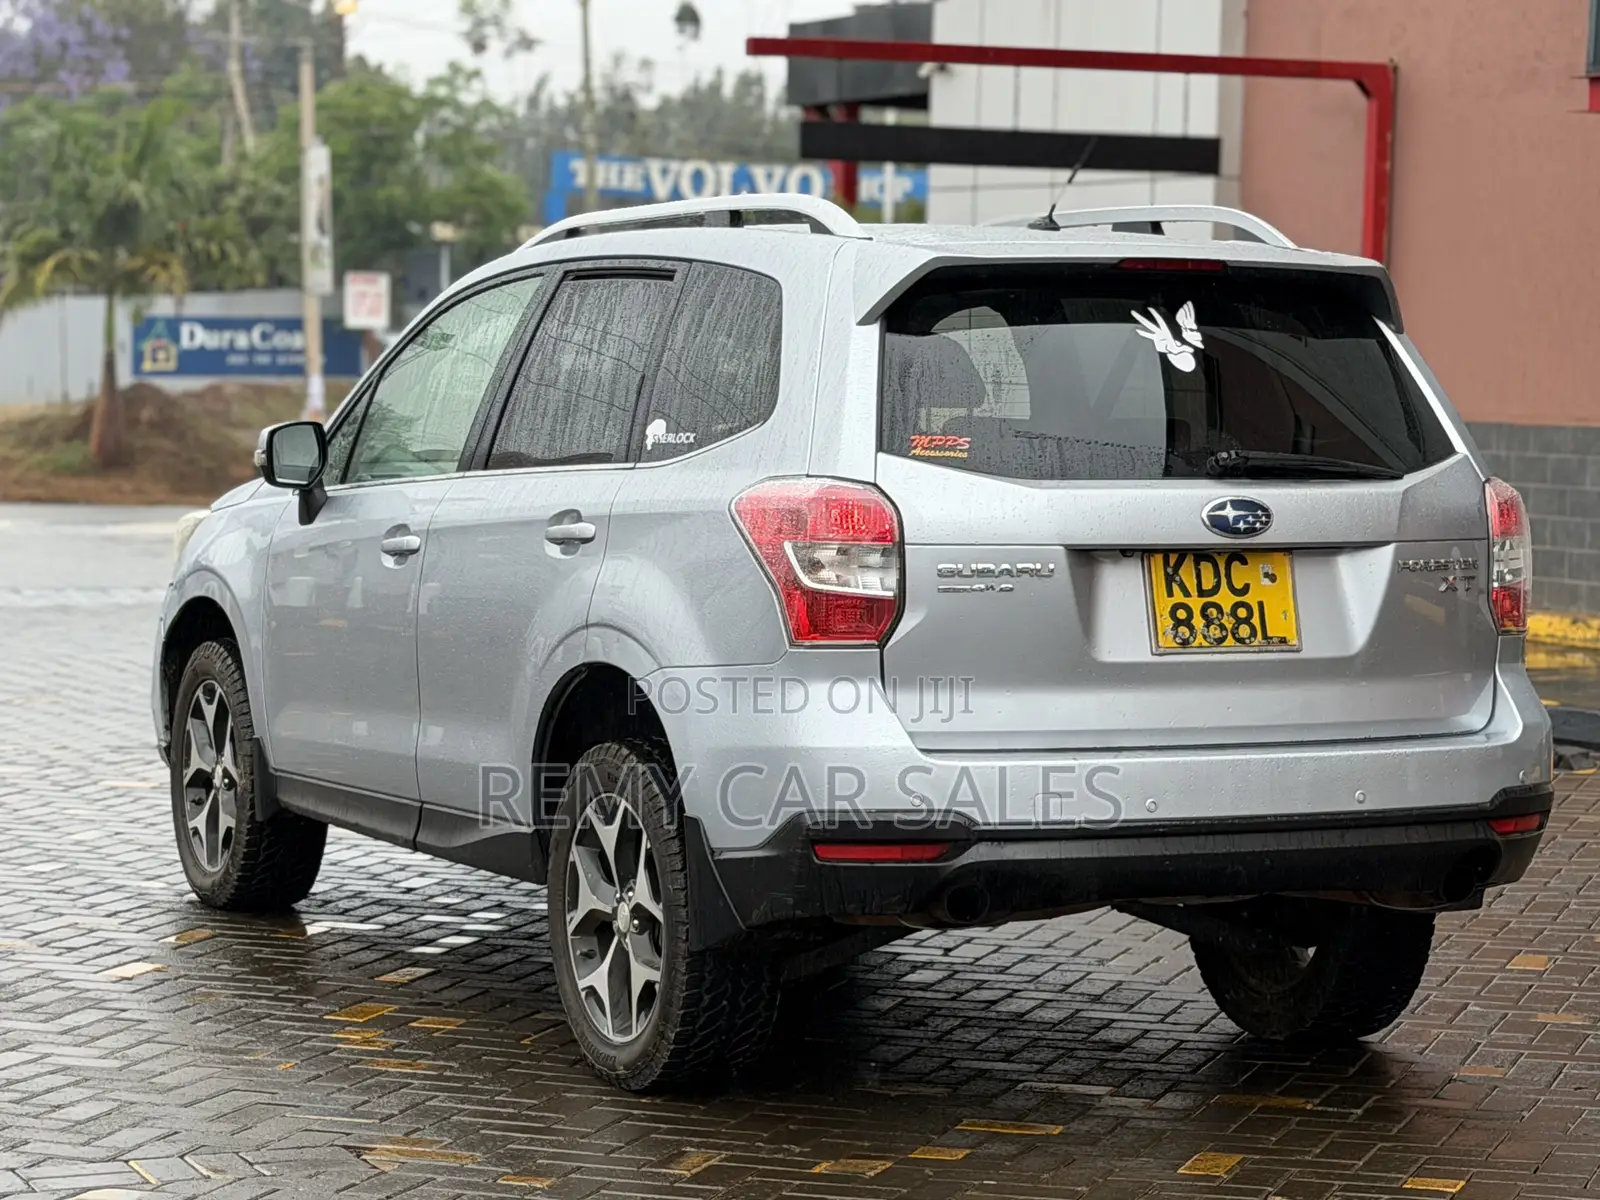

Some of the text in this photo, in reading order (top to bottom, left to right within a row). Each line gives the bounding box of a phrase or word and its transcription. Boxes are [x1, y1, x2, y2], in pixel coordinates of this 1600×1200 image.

[569, 158, 645, 191] THE
[645, 157, 824, 200] VOLVO
[179, 321, 306, 351] DuraCoa
[910, 435, 972, 450] MPPS
[936, 562, 1055, 579] SUBARU
[1162, 552, 1251, 599] KDC
[1438, 575, 1477, 593] XT
[1169, 600, 1287, 646] 888L
